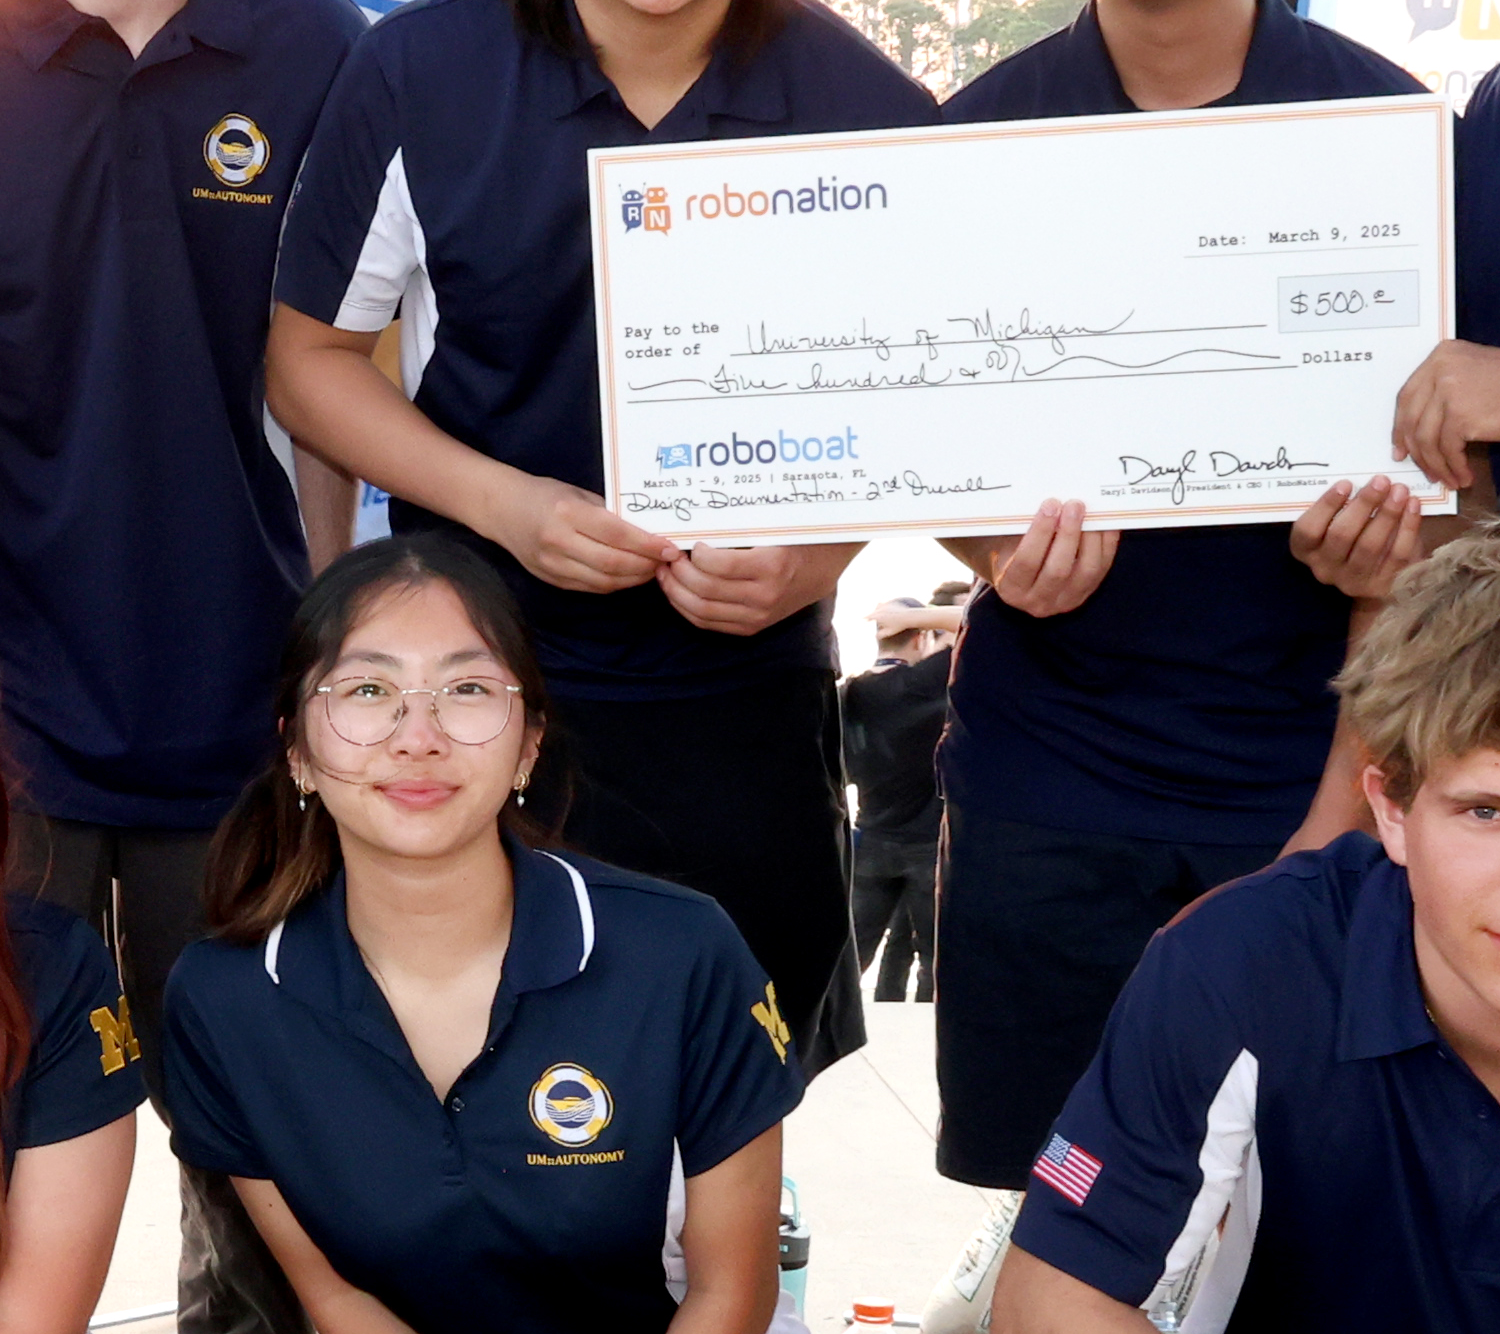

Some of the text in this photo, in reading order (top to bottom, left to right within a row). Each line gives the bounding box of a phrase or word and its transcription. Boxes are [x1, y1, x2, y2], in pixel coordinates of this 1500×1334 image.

[685, 176, 887, 221] robonation
[1198, 224, 1402, 248] Date: March 9, 2025
[624, 322, 720, 340] Pay to the
[747, 307, 1135, 361] University of Michigan
[625, 343, 701, 359] order of
[1302, 349, 1374, 365] Dollars
[695, 425, 859, 467] roboboat
[643, 478, 679, 488] March
[685, 478, 692, 487] 3
[713, 475, 726, 486] 9,
[733, 473, 762, 484] 2025
[782, 471, 844, 482] Sarasota,
[852, 468, 866, 479] FL
[1186, 483, 1231, 492] President
[620, 492, 699, 521] Design
[701, 478, 844, 508] Documentation
[865, 476, 901, 500] 2nd
